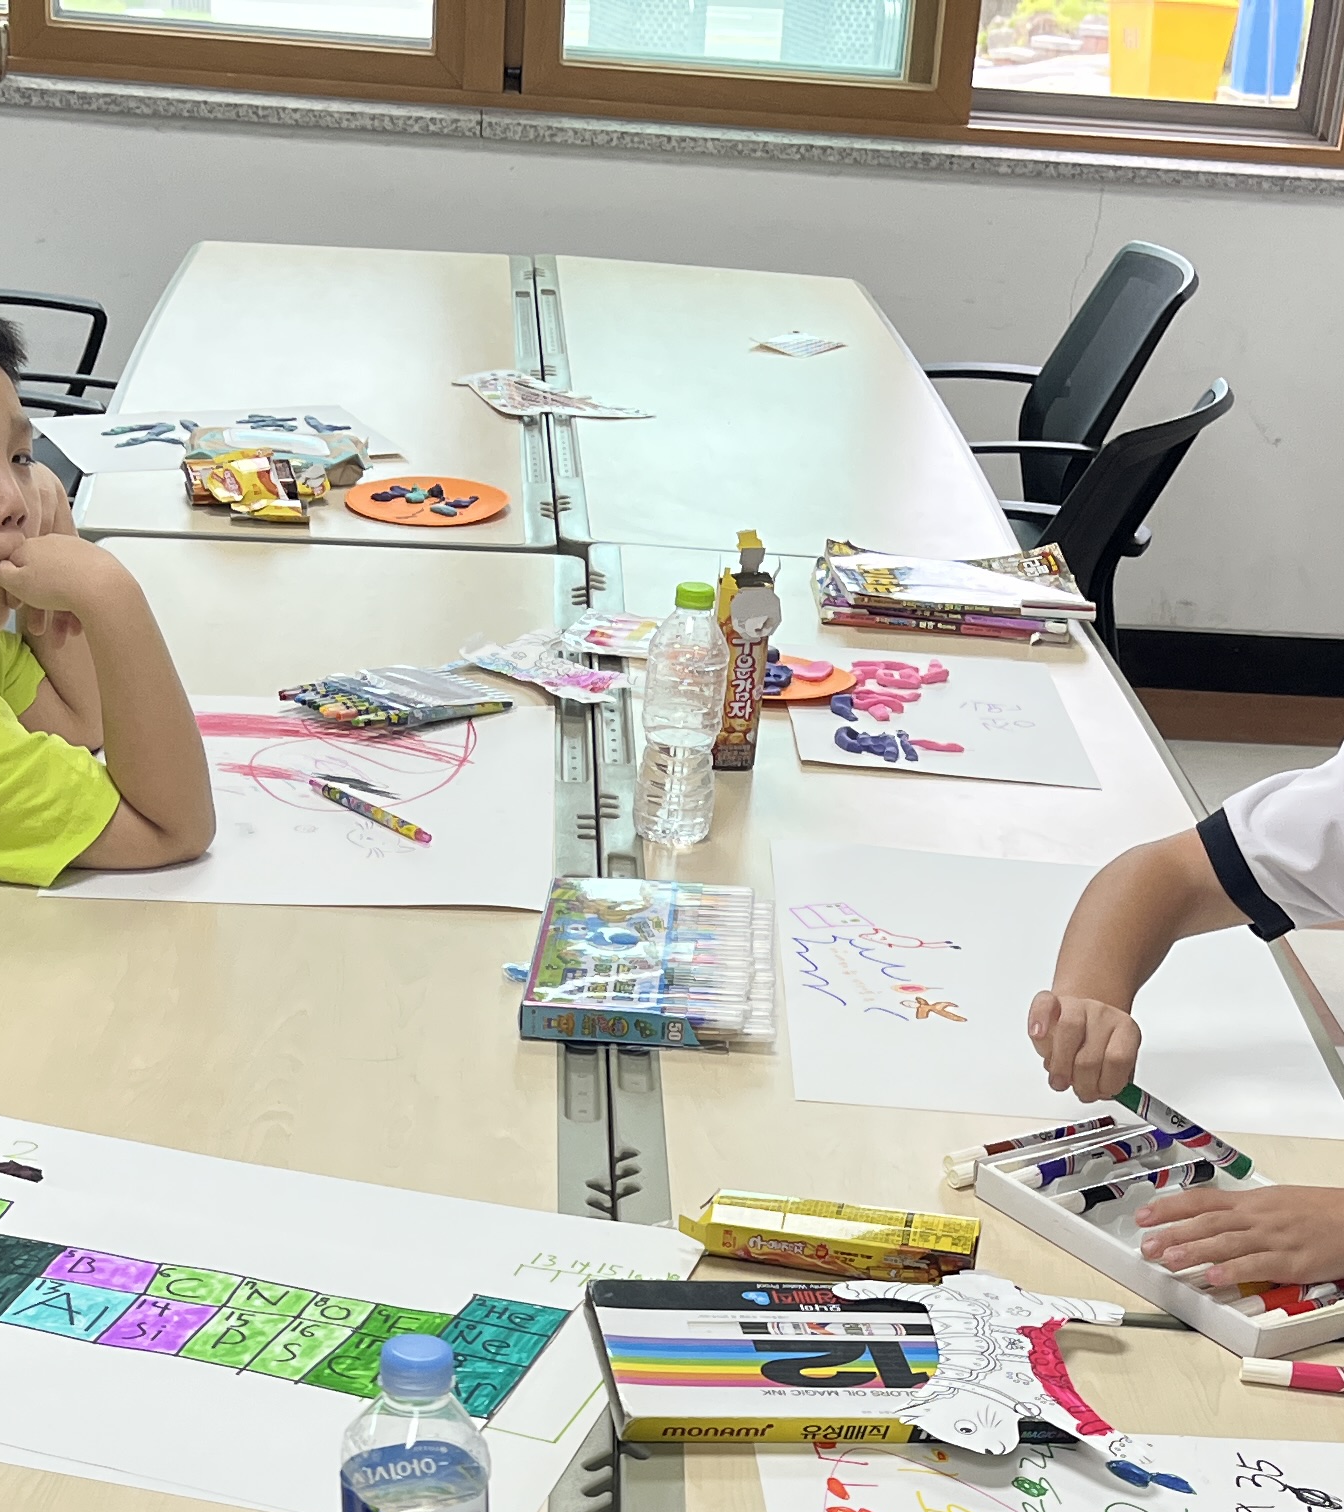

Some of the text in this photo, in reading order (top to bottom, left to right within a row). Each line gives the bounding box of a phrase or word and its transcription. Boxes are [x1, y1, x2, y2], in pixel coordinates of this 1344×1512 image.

[531, 1252, 557, 1266] 13
[597, 1263, 623, 1276] 15
[67, 1256, 96, 1274] B
[166, 1278, 204, 1298] C
[247, 1288, 290, 1306] N
[484, 1303, 536, 1329] He
[12, 1292, 110, 1332] Al
[274, 1342, 302, 1362] S
[452, 1328, 511, 1357] Ne
[752, 1340, 930, 1388] 12
[661, 1423, 890, 1441] monami 유성매직
